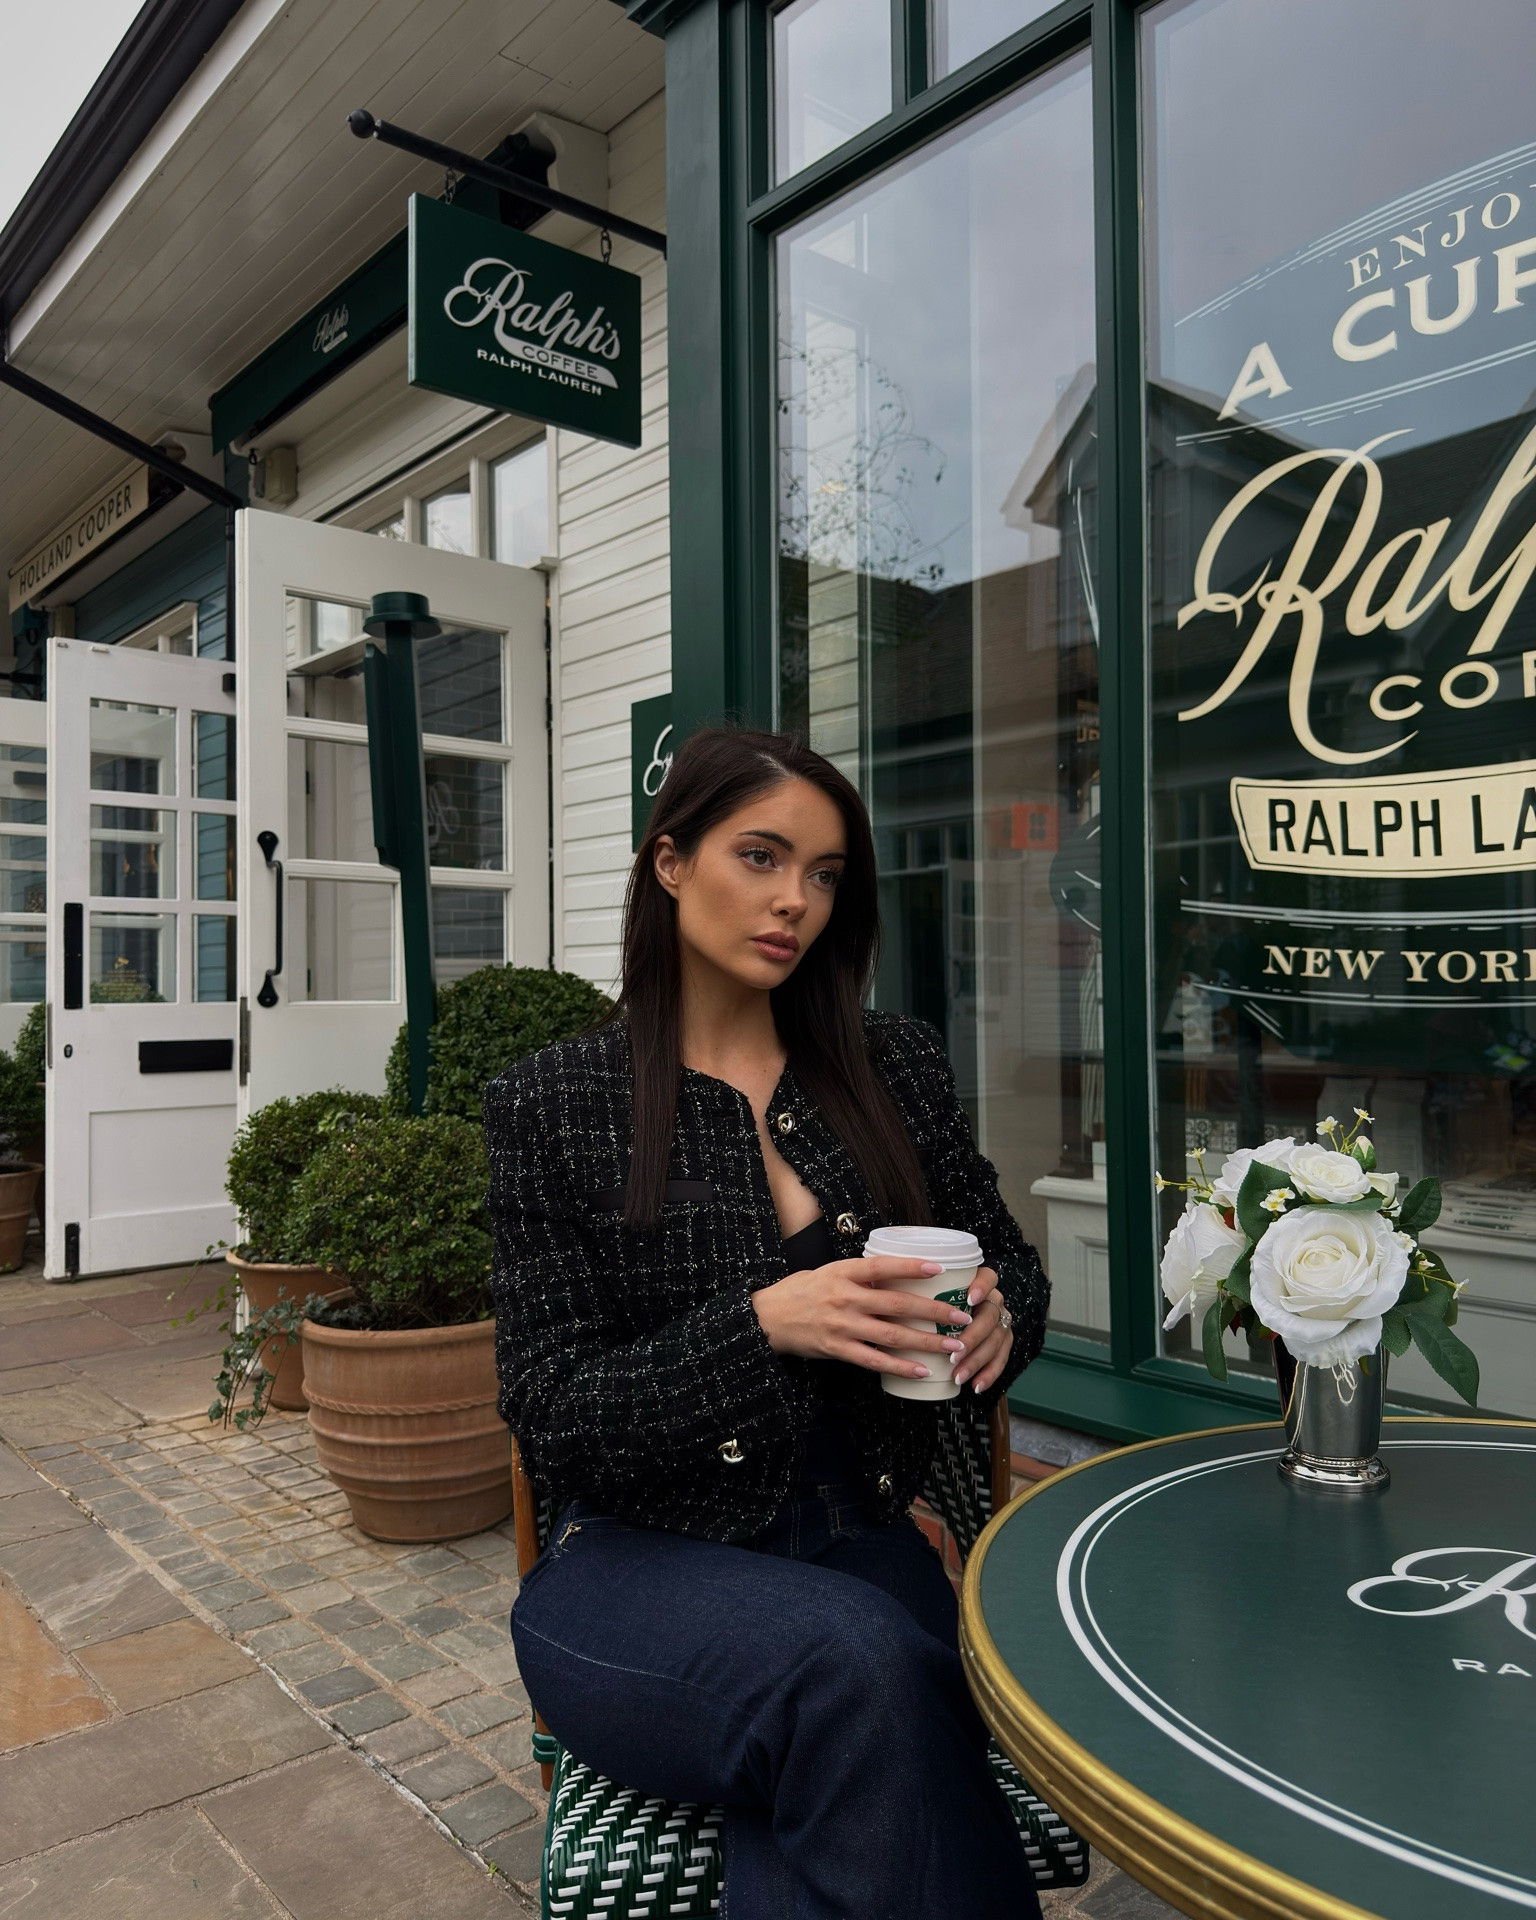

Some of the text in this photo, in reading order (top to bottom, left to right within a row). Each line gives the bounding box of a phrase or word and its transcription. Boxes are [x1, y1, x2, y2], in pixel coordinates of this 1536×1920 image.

[1347, 184, 1536, 292] ENJO
[443, 257, 621, 361] Ralph's
[476, 348, 602, 396] RALPH LAUREN
[522, 345, 598, 380] COFFEE
[1216, 341, 1293, 421] A
[19, 484, 132, 596] HOLLAND COOPER
[1268, 797, 1443, 858] RALPH
[1262, 944, 1385, 981] NEW
[1451, 1658, 1533, 1678] RA
